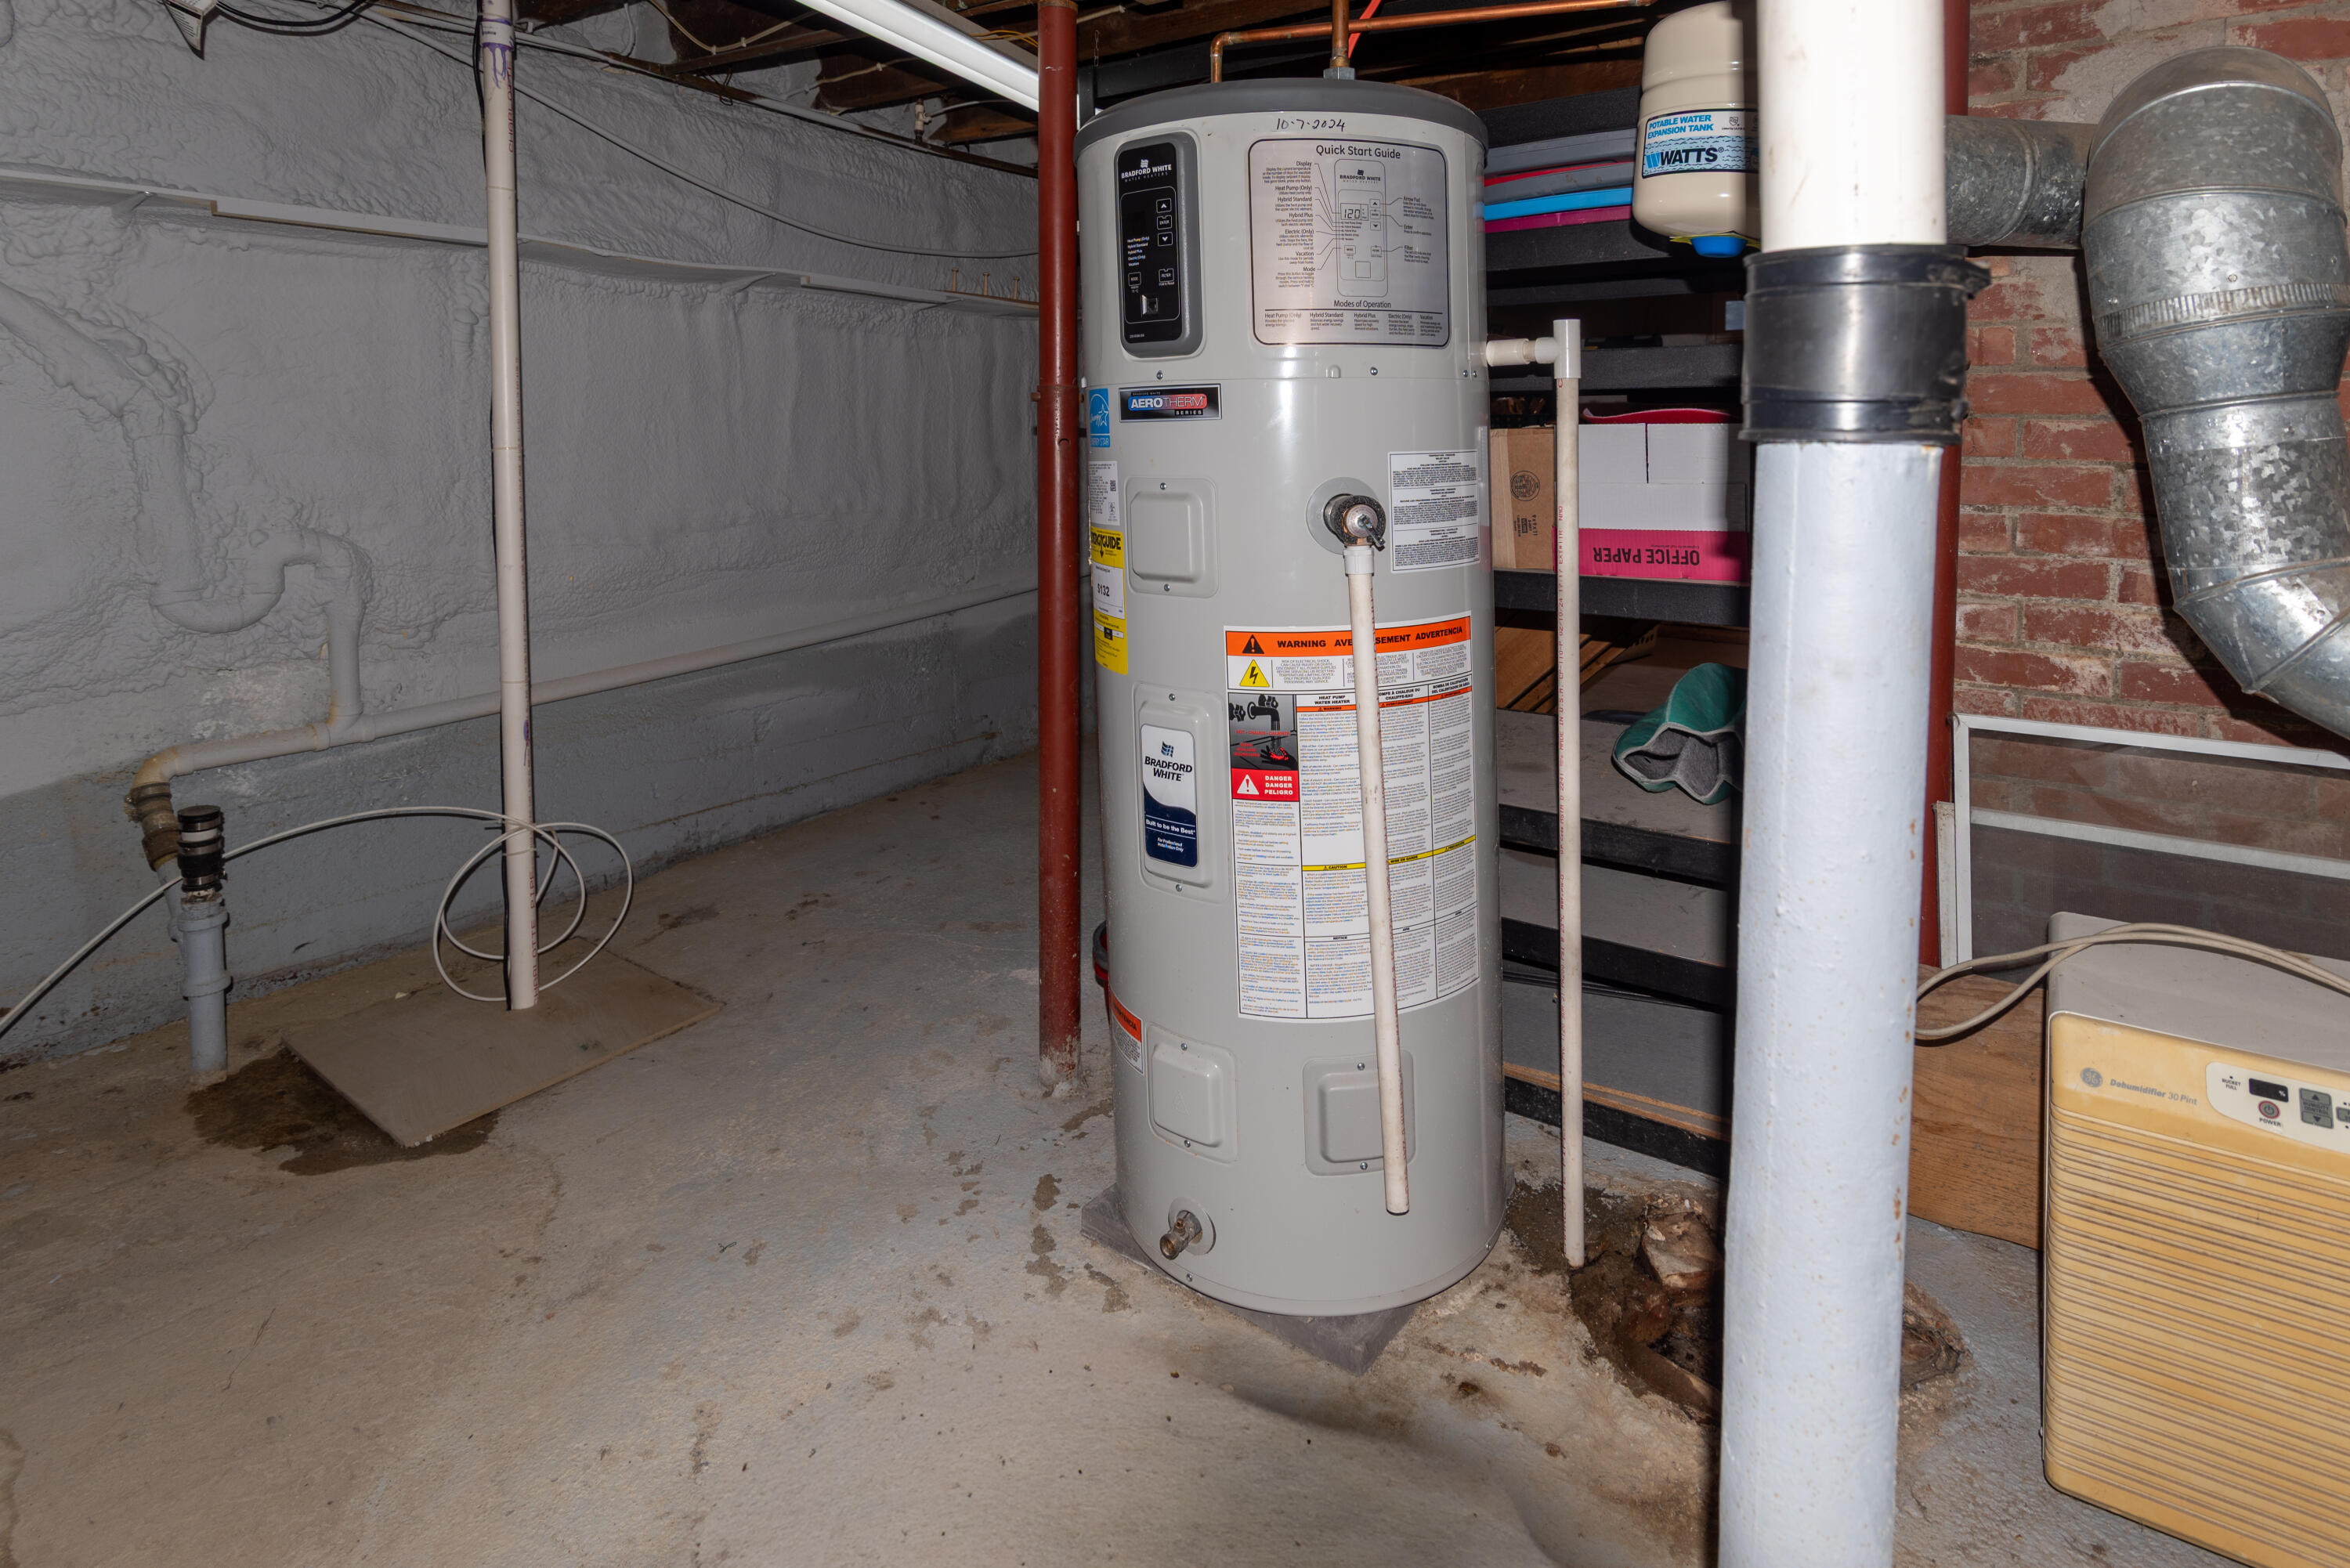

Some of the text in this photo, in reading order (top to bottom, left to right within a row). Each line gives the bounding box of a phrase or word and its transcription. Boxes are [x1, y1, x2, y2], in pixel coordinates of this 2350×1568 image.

[1649, 114, 1711, 131] POTABLE WATER
[1647, 126, 1686, 139] EXPANSION
[1316, 145, 1401, 159] Quick Start Guide
[1661, 147, 1718, 166] WATTS
[1122, 164, 1172, 179] BRADFORD WHITE
[1344, 208, 1361, 219] 120
[1363, 301, 1391, 309] Operation
[1130, 396, 1203, 410] AEROTHERM
[1593, 547, 1700, 565] OFFICE PAPER
[1097, 583, 1110, 597] $132
[1277, 626, 1463, 649] WARNING AVESEMENT ADVERTENCIA
[1144, 755, 1193, 774] BRADFORD
[1153, 768, 1182, 782] WHITE
[1145, 818, 1156, 829] Built
[1170, 824, 1180, 833] the
[2222, 1078, 2242, 1087] BUCKET
[2110, 1078, 2198, 1106] Dehumidifier 30 Pint
[2303, 1101, 2329, 1111] HUMIDITY
[2304, 1105, 2329, 1116] CONTROL
[2259, 1117, 2282, 1128] POWER
